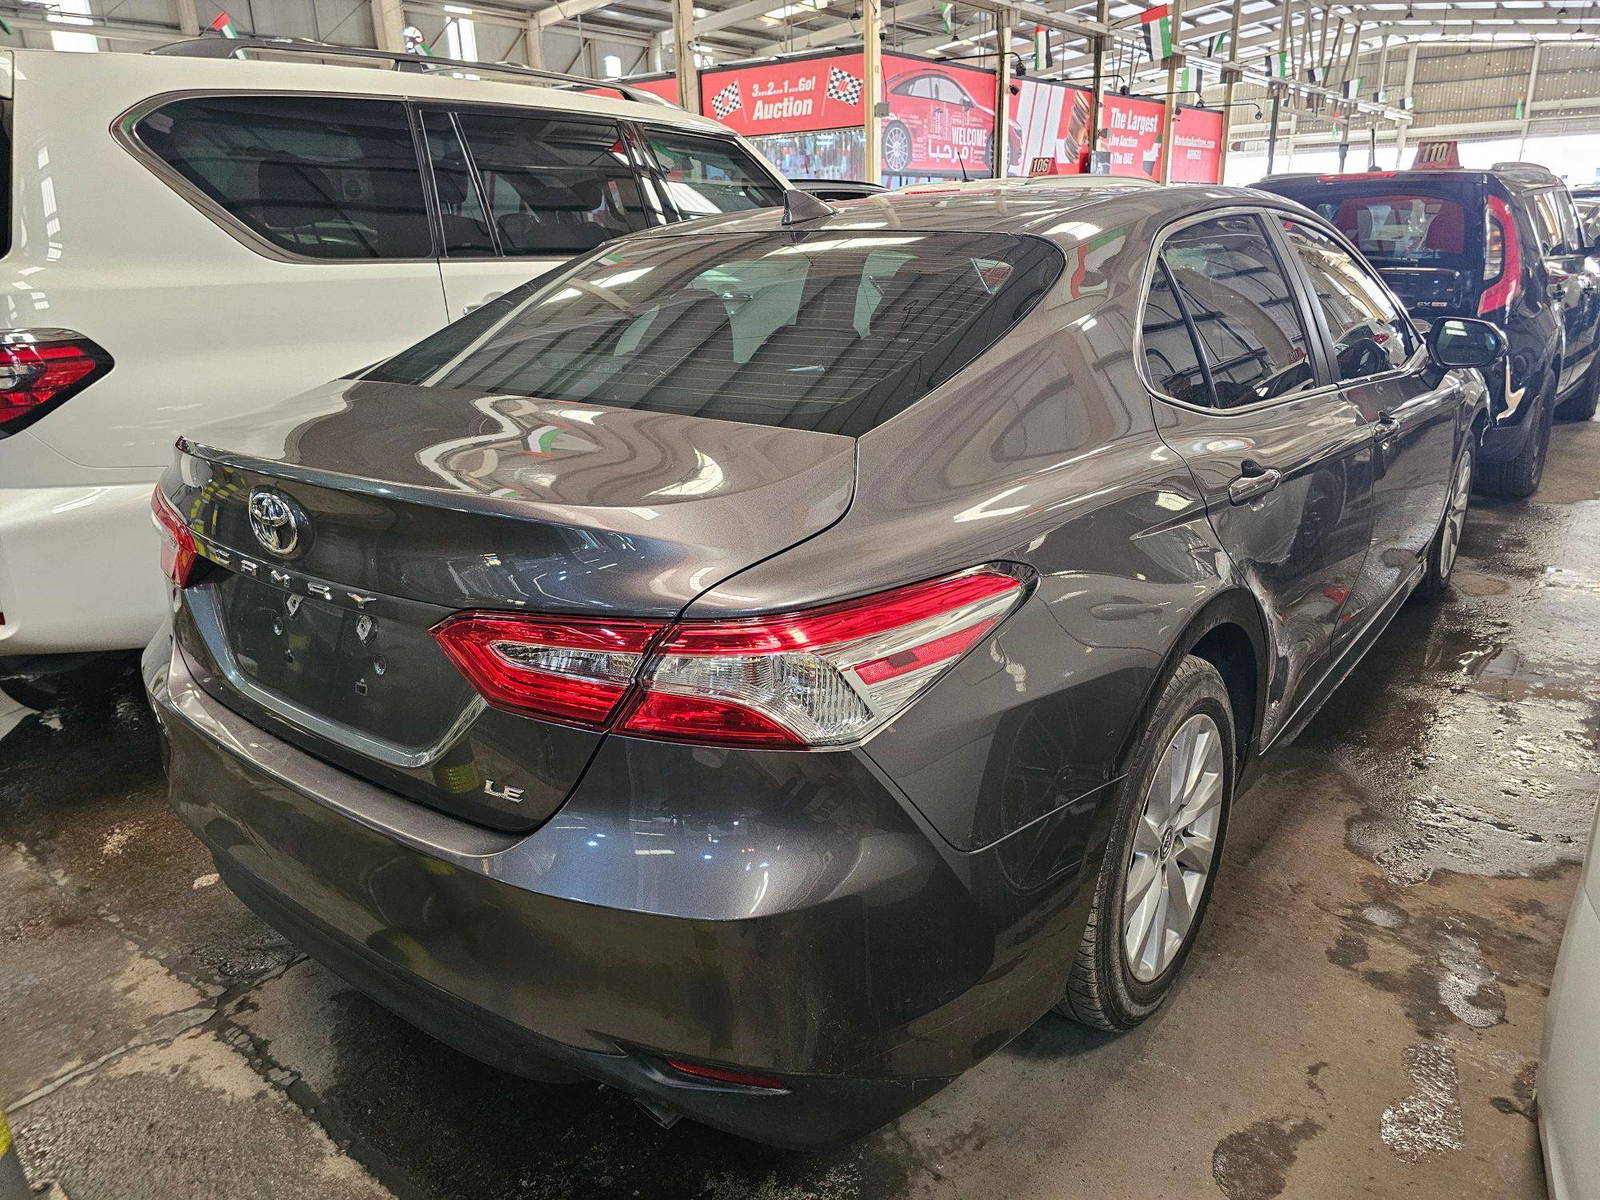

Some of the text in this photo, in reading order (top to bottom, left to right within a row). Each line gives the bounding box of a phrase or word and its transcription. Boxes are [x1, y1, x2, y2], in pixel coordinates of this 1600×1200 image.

[752, 96, 813, 120] Auction
[1111, 107, 1159, 136] The Largest
[952, 127, 987, 147] WELCOME
[928, 138, 969, 164] مرحبا
[1423, 143, 1449, 163] 110
[1033, 158, 1049, 172] 106
[215, 548, 376, 607] CAMRY
[485, 779, 525, 803] LE
